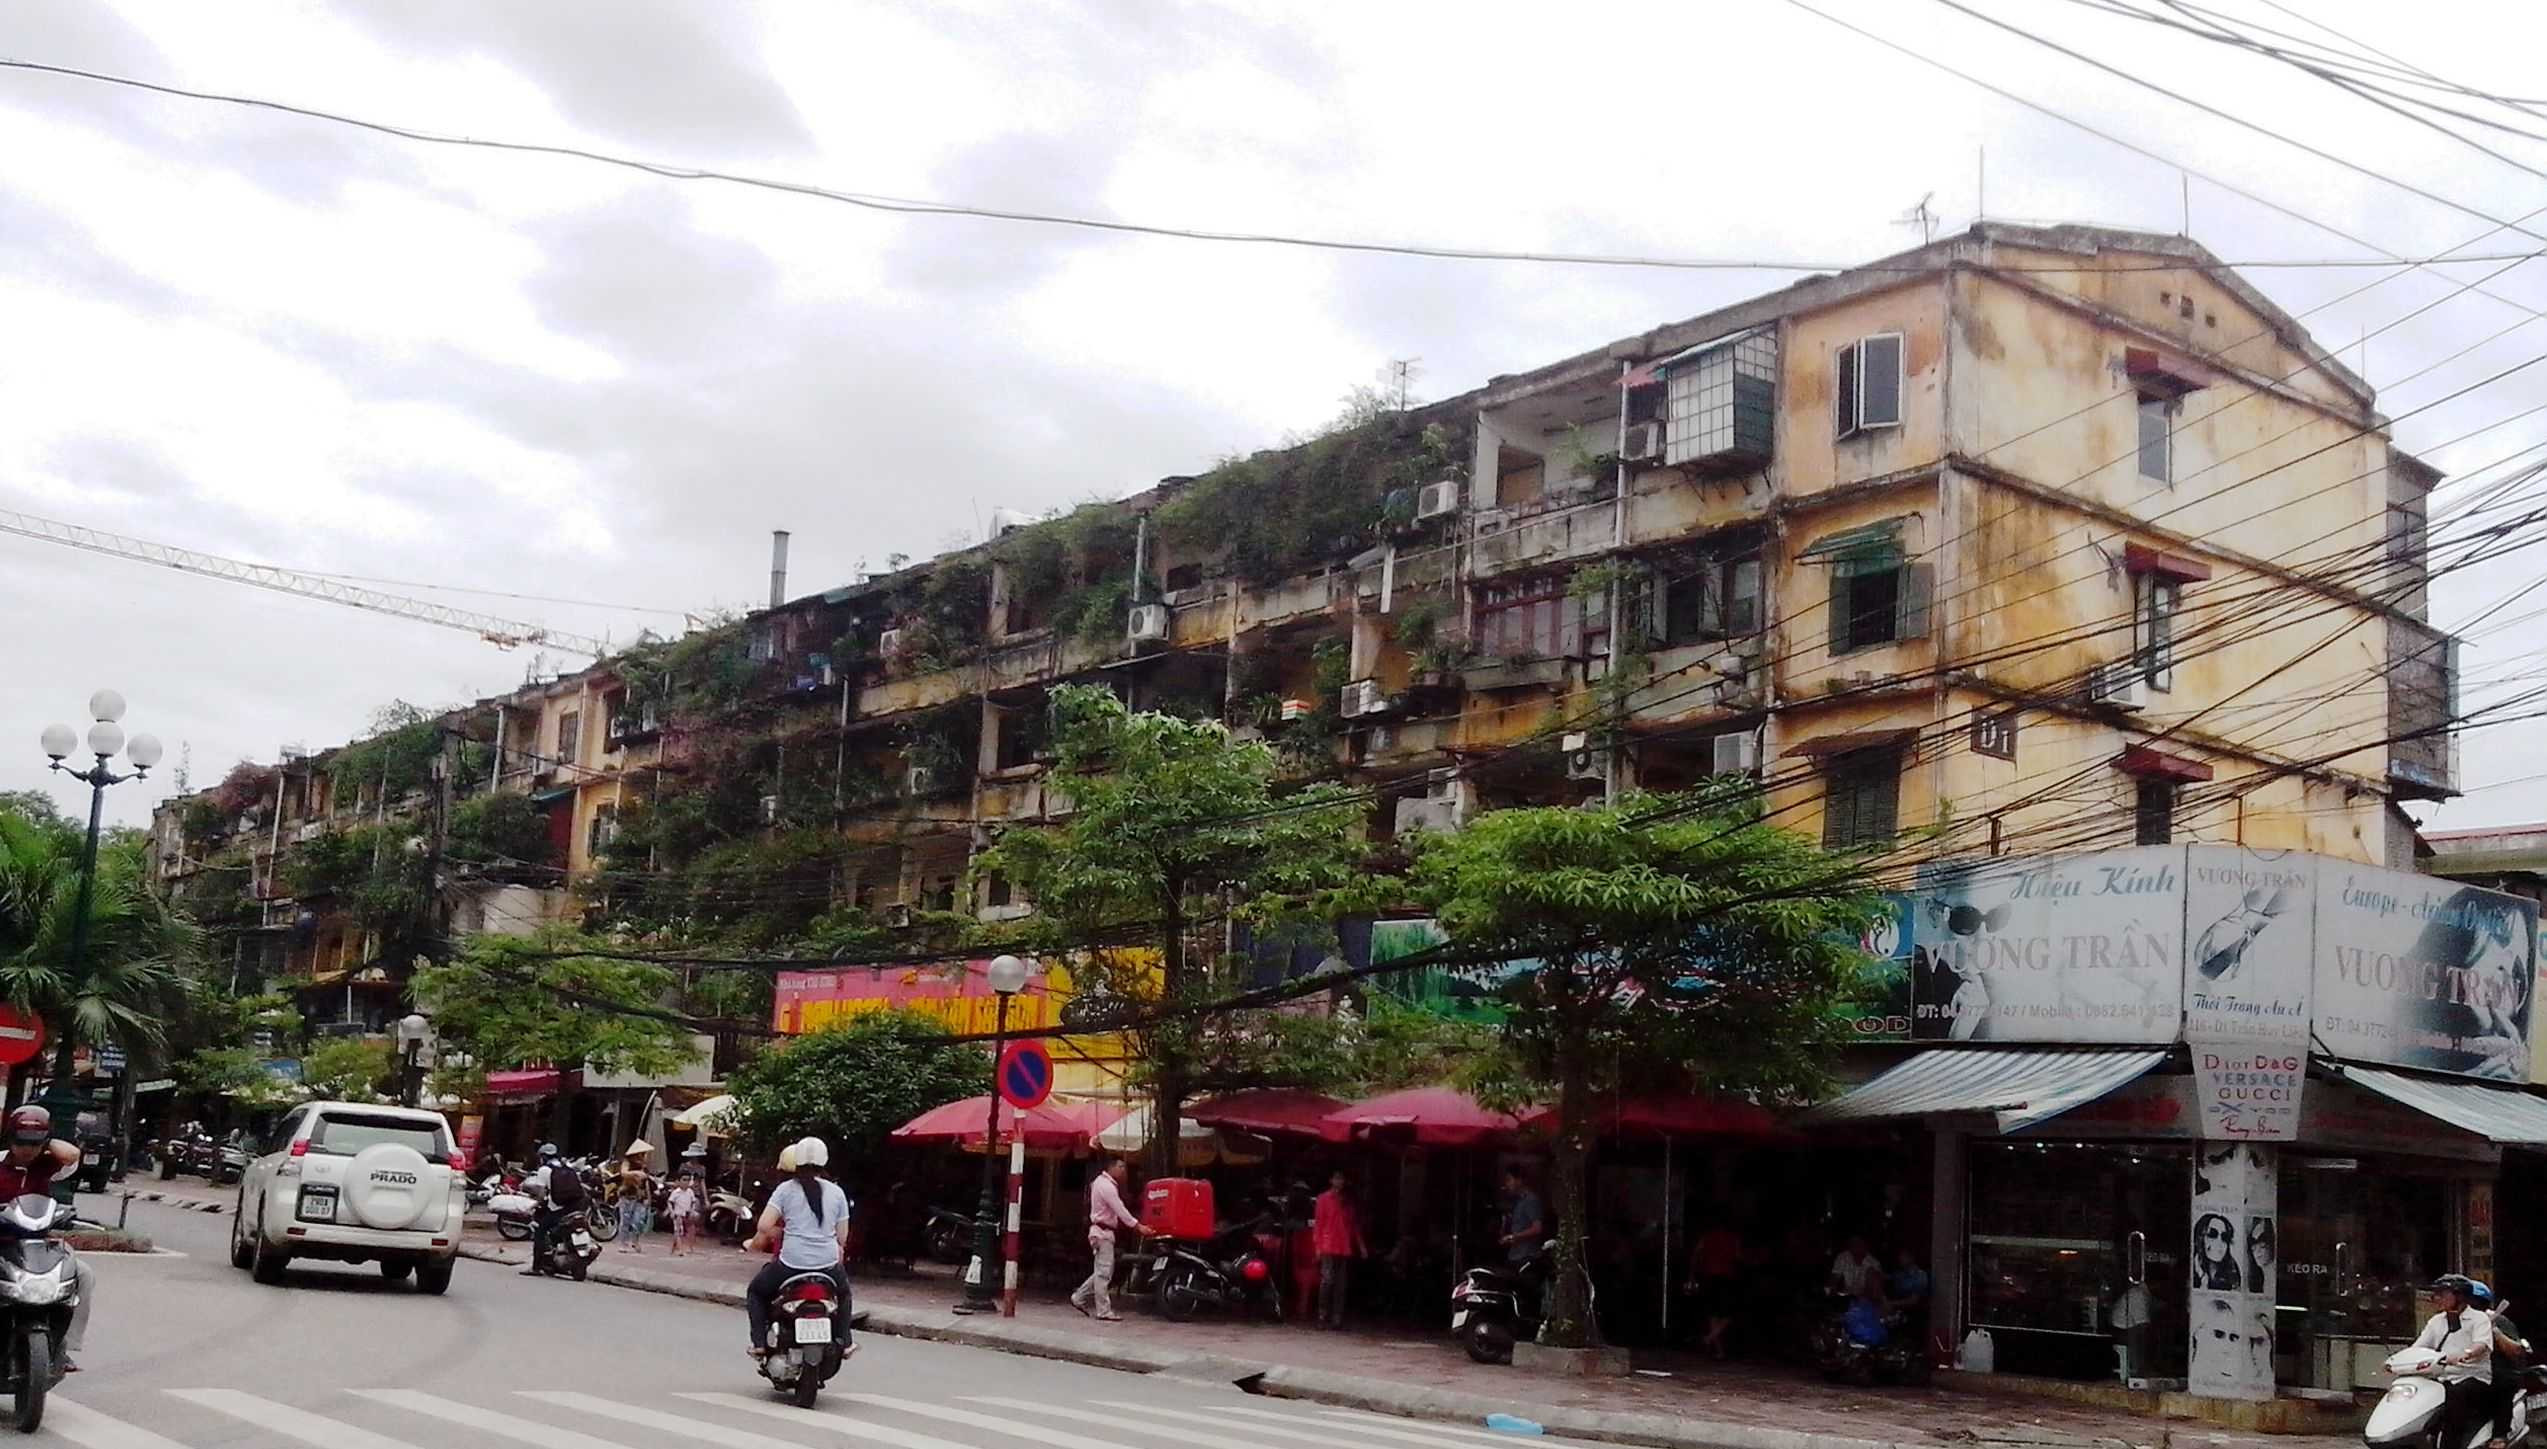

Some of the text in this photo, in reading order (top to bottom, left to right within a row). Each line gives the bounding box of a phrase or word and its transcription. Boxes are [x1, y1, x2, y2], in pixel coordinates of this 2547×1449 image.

[2091, 864, 2176, 896] Kính
[2203, 1054, 2298, 1071] Dior D&G
[2211, 1073, 2297, 1087] VERSACE
[2218, 1088, 2290, 1101] GUCCI
[369, 1173, 417, 1185] PRADO
